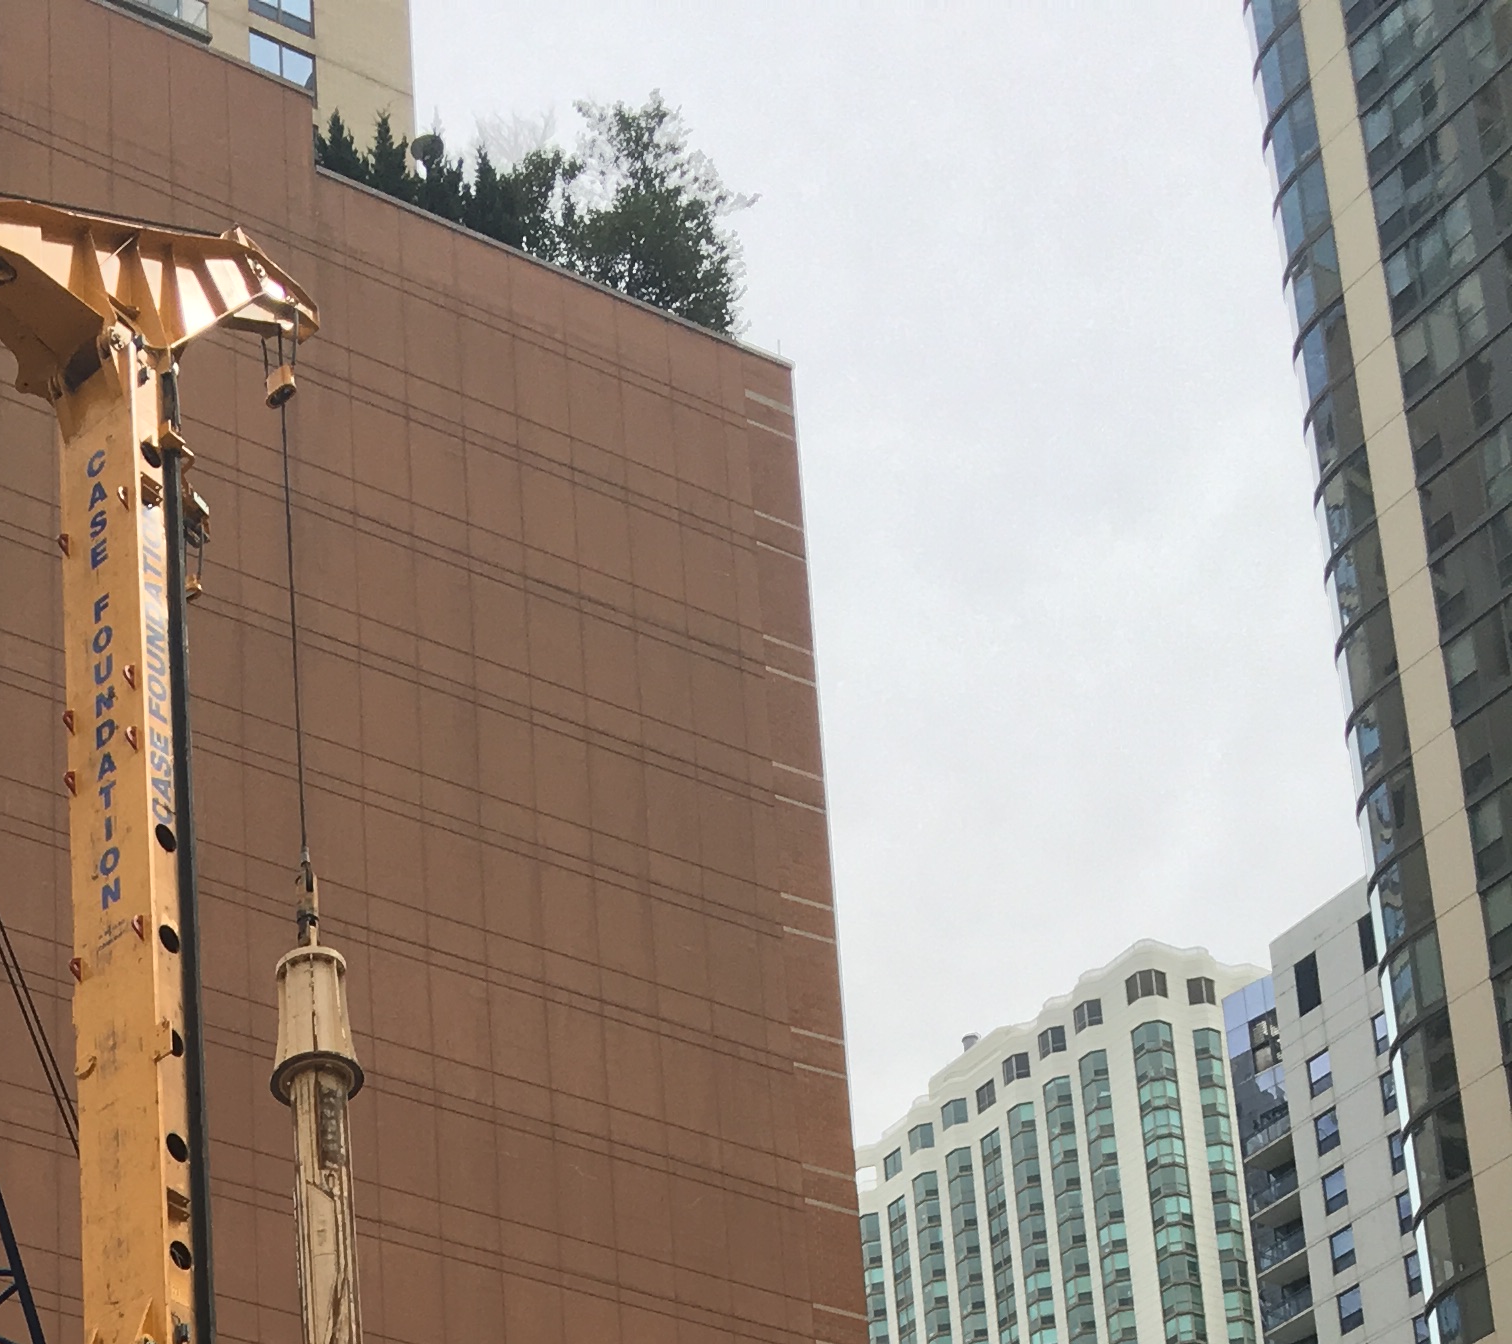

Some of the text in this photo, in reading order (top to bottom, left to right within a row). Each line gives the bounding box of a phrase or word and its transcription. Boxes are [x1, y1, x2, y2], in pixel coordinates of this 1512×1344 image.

[86, 449, 109, 571] CASE
[142, 508, 174, 825] CASE FOUNDATIO
[90, 593, 122, 912] FOUNDATION
